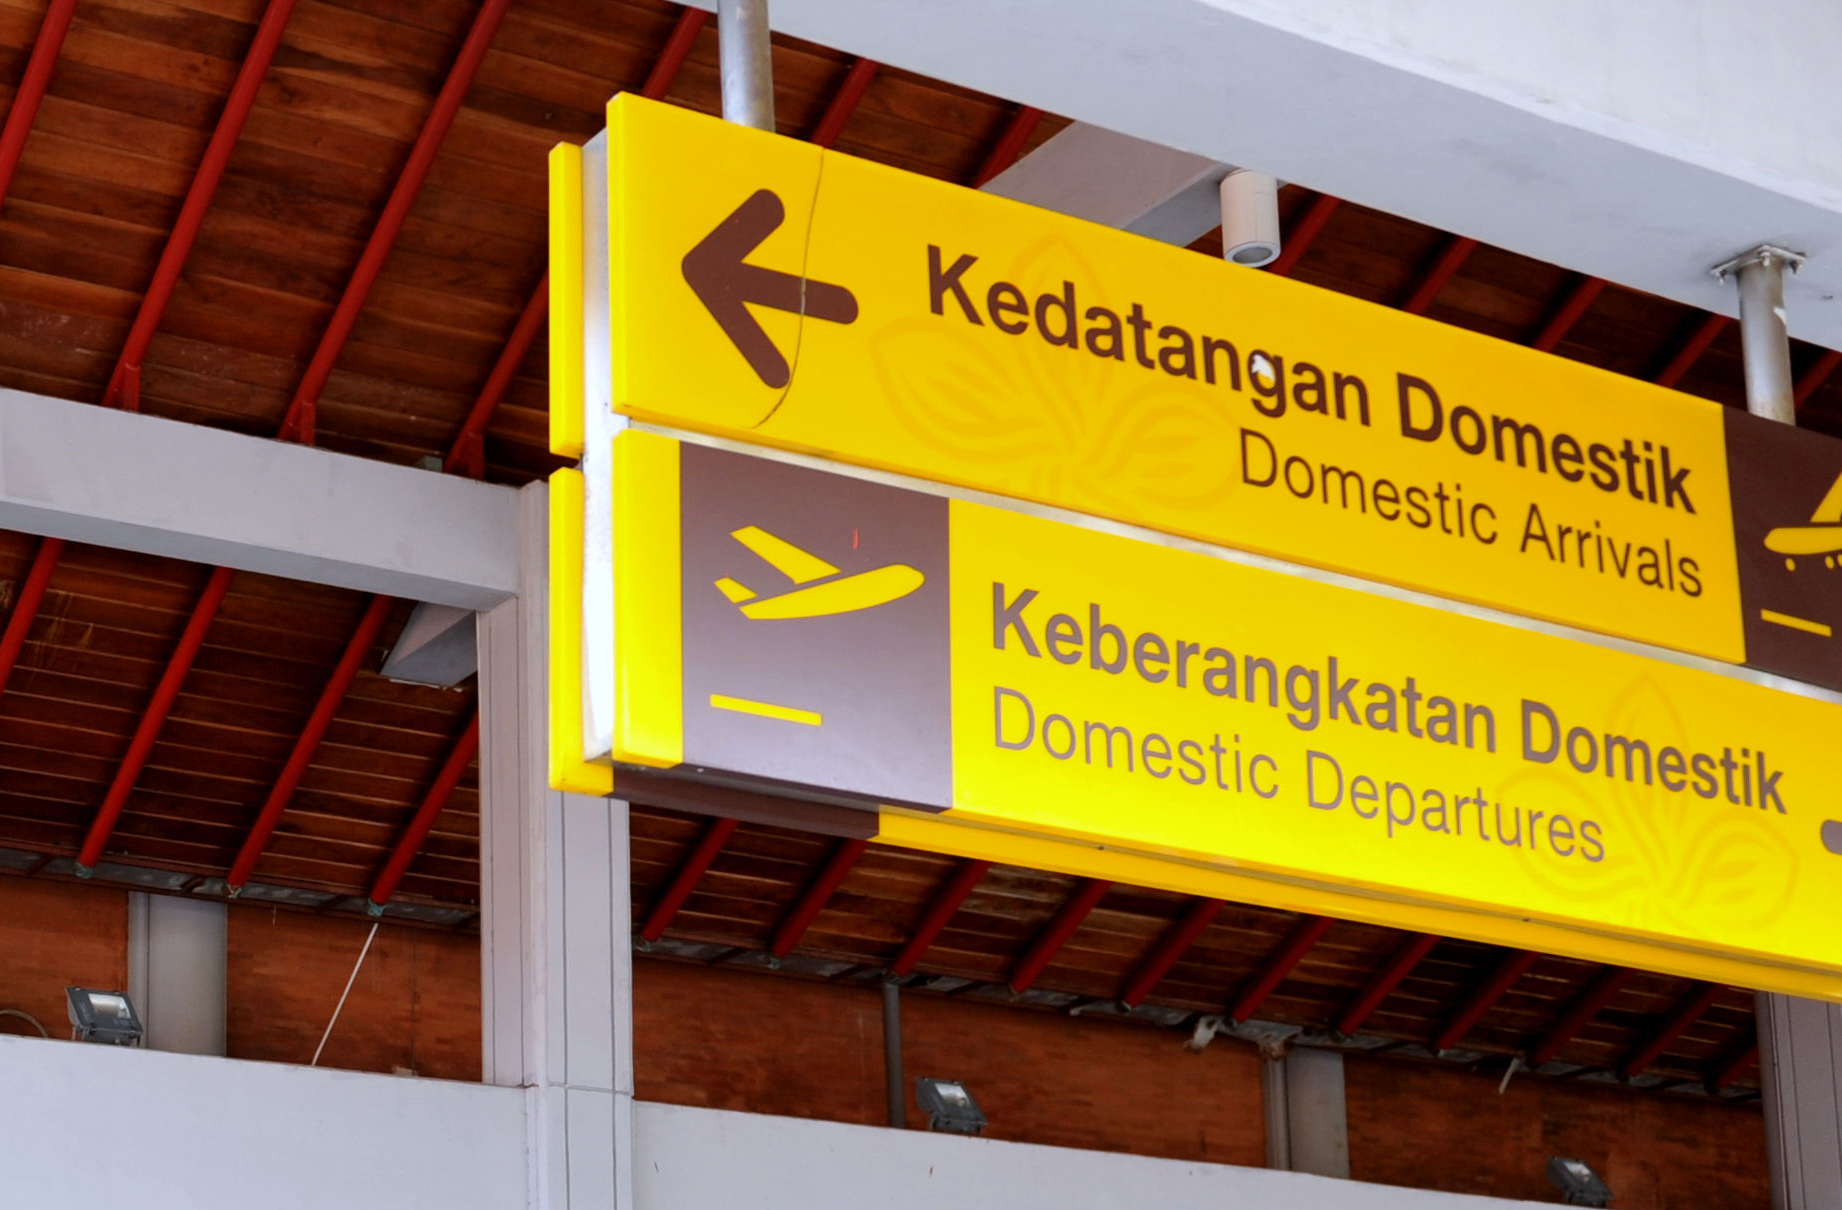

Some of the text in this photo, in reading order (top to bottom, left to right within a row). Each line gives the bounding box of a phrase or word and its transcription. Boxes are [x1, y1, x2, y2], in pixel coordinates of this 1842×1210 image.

[926, 243, 1698, 516] Kedatangan Domestik
[1239, 427, 1704, 599] Domestic Arrivals
[991, 581, 1788, 815] Keberangkatan Domestik
[993, 686, 1606, 863] Domestic Departures
